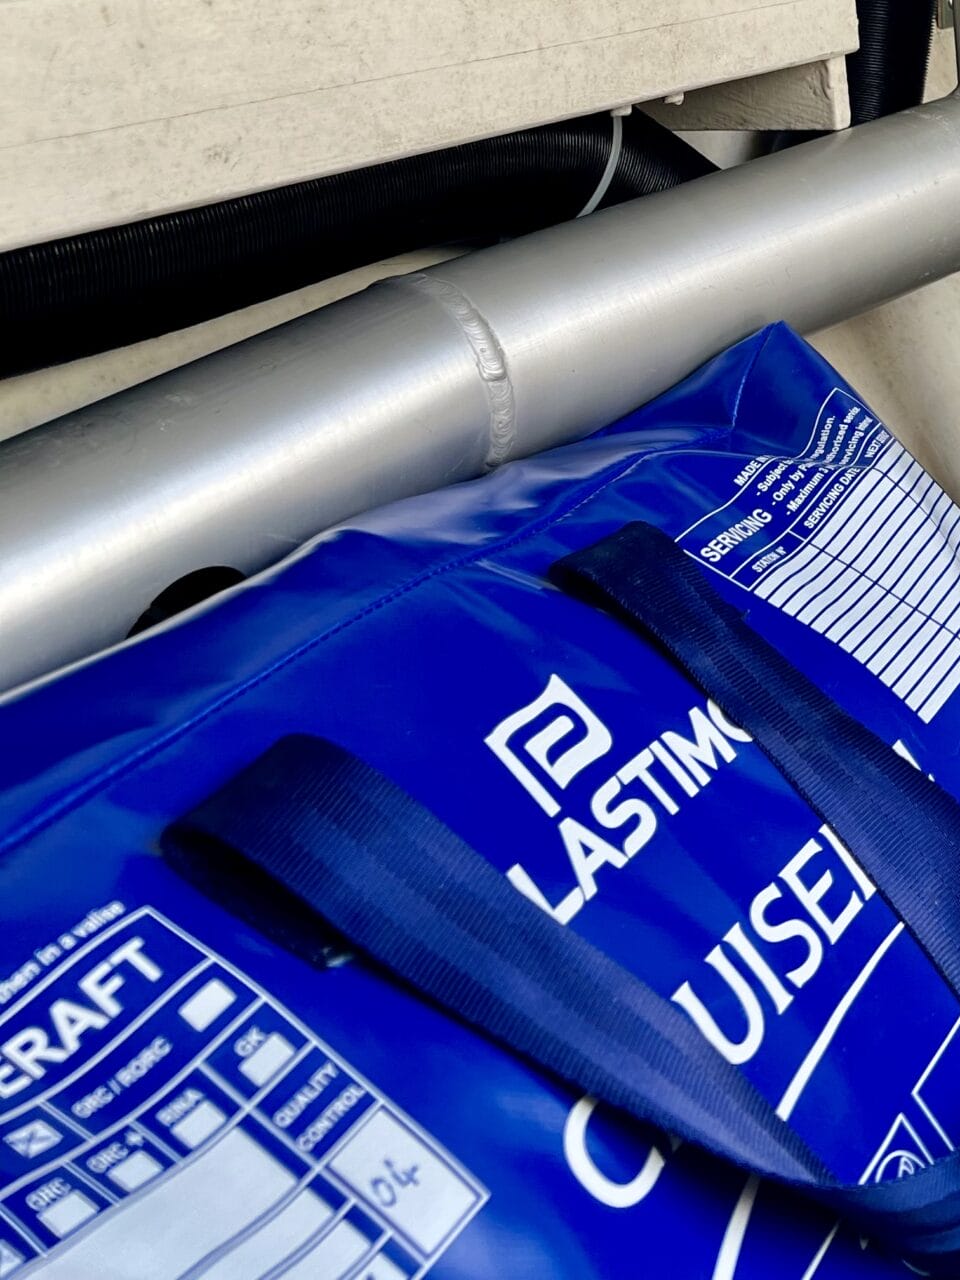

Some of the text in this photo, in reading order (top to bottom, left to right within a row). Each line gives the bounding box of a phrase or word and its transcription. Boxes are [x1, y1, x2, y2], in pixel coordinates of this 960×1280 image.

[733, 460, 762, 487] MADE
[757, 462, 788, 492] Subject
[773, 480, 795, 501] Only
[789, 470, 805, 481] by
[787, 472, 825, 512] Maximum
[803, 483, 845, 529] SERVICING
[839, 467, 861, 485] DATE
[700, 508, 772, 562] SERVICING
[505, 698, 755, 927] LASTIM
[272, 1061, 340, 1129] QUALITY
[296, 1084, 369, 1153] CONTROL
